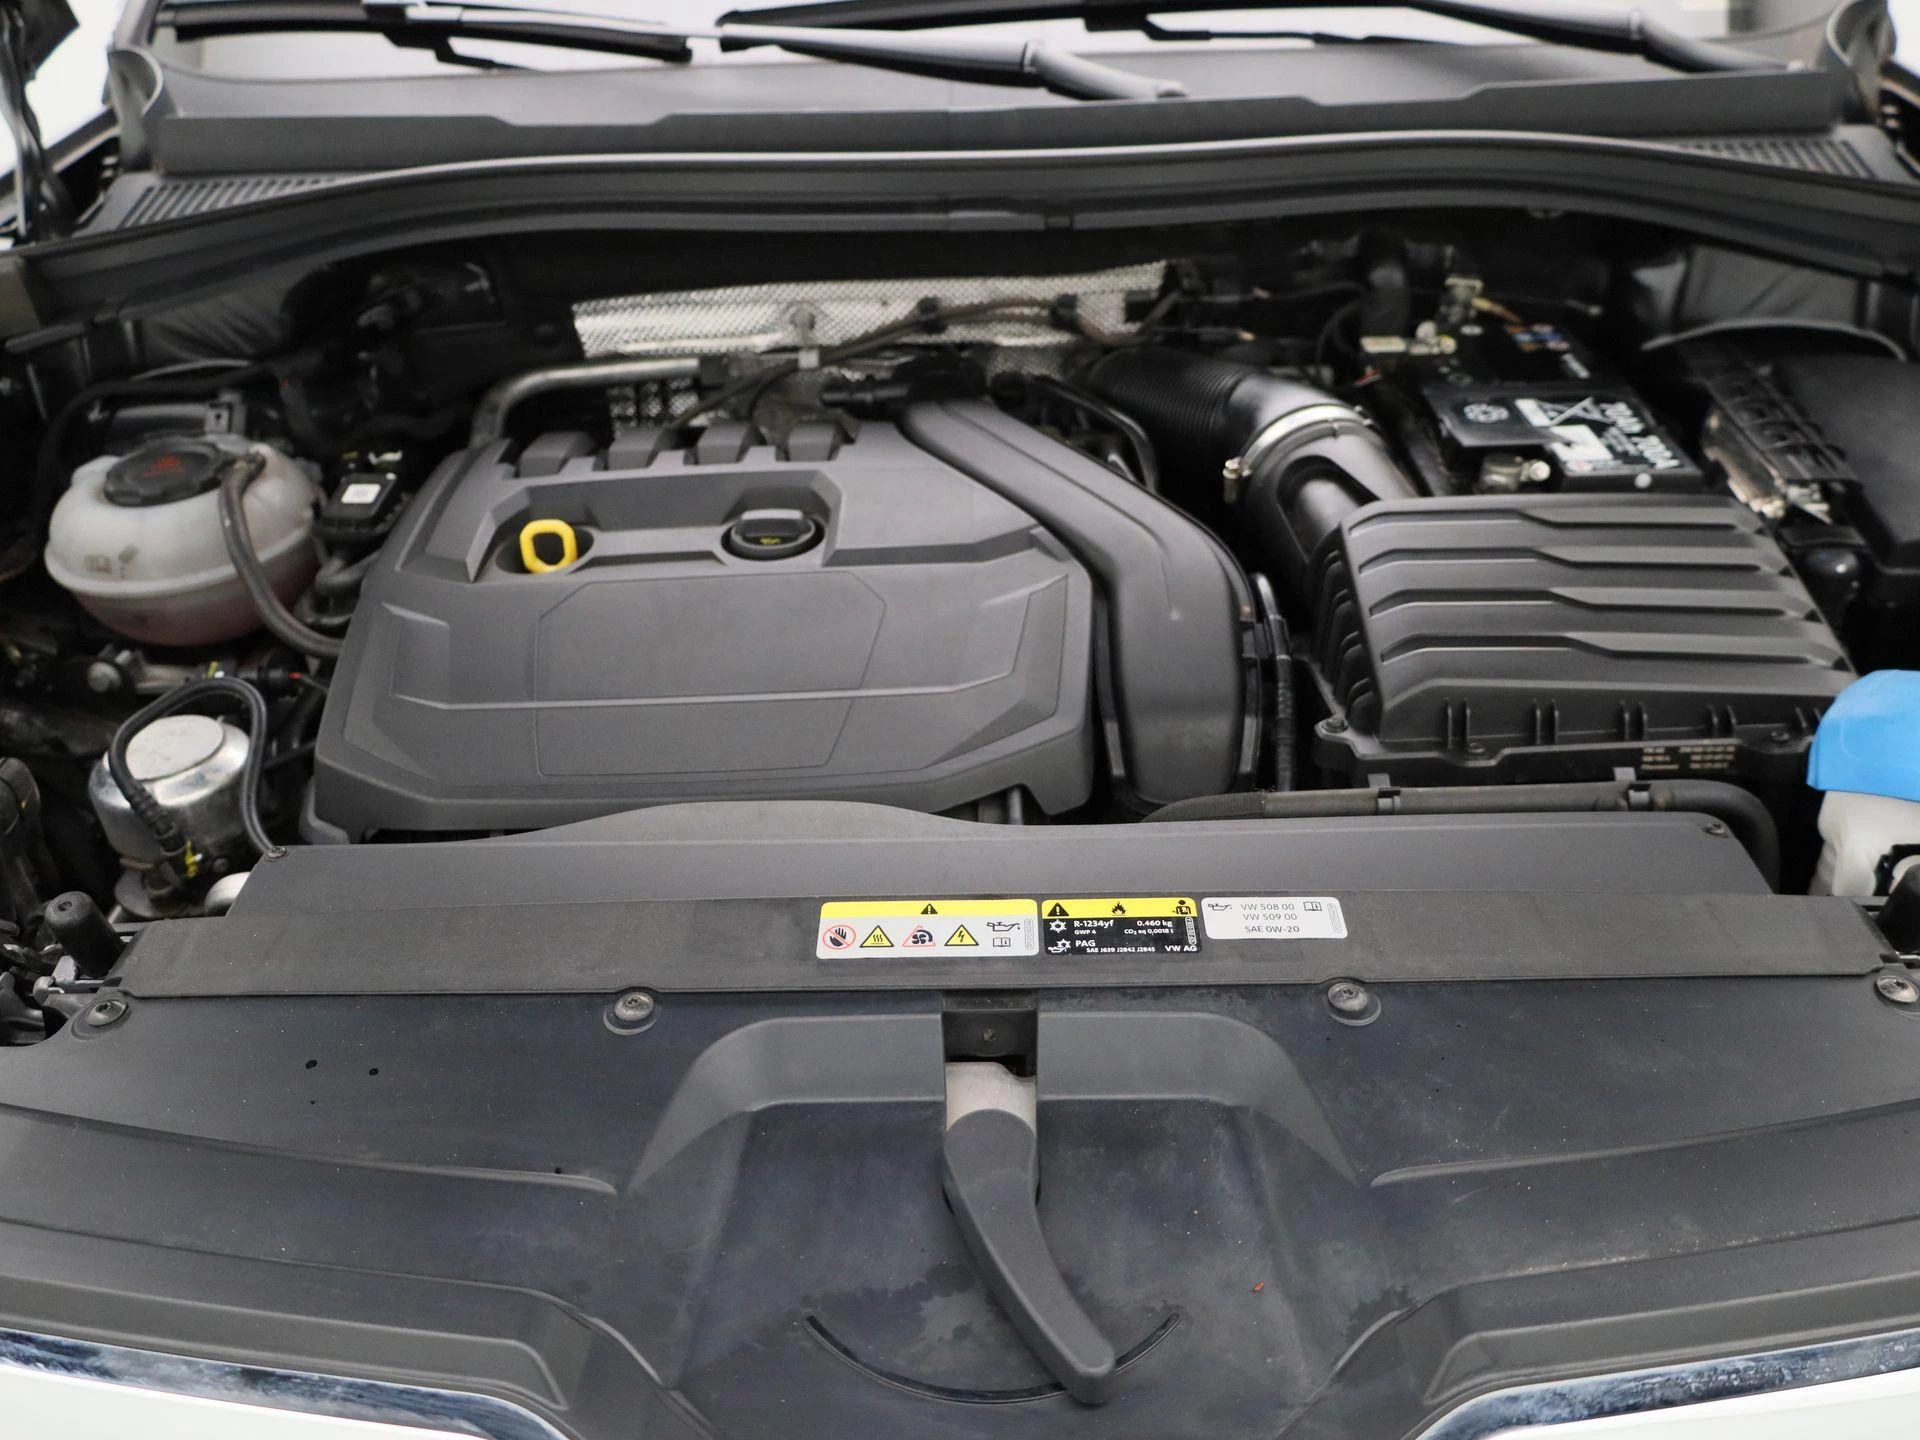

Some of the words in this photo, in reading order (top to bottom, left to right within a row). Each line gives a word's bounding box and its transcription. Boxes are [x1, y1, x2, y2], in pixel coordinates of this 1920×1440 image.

[1240, 903, 1257, 911] VW
[1260, 903, 1279, 911] 508
[1243, 913, 1260, 921] VW
[1073, 919, 1114, 929] R-1234yf
[1162, 919, 1173, 928] kg
[1265, 925, 1300, 933] 0W-20
[1075, 939, 1096, 947] PAG
